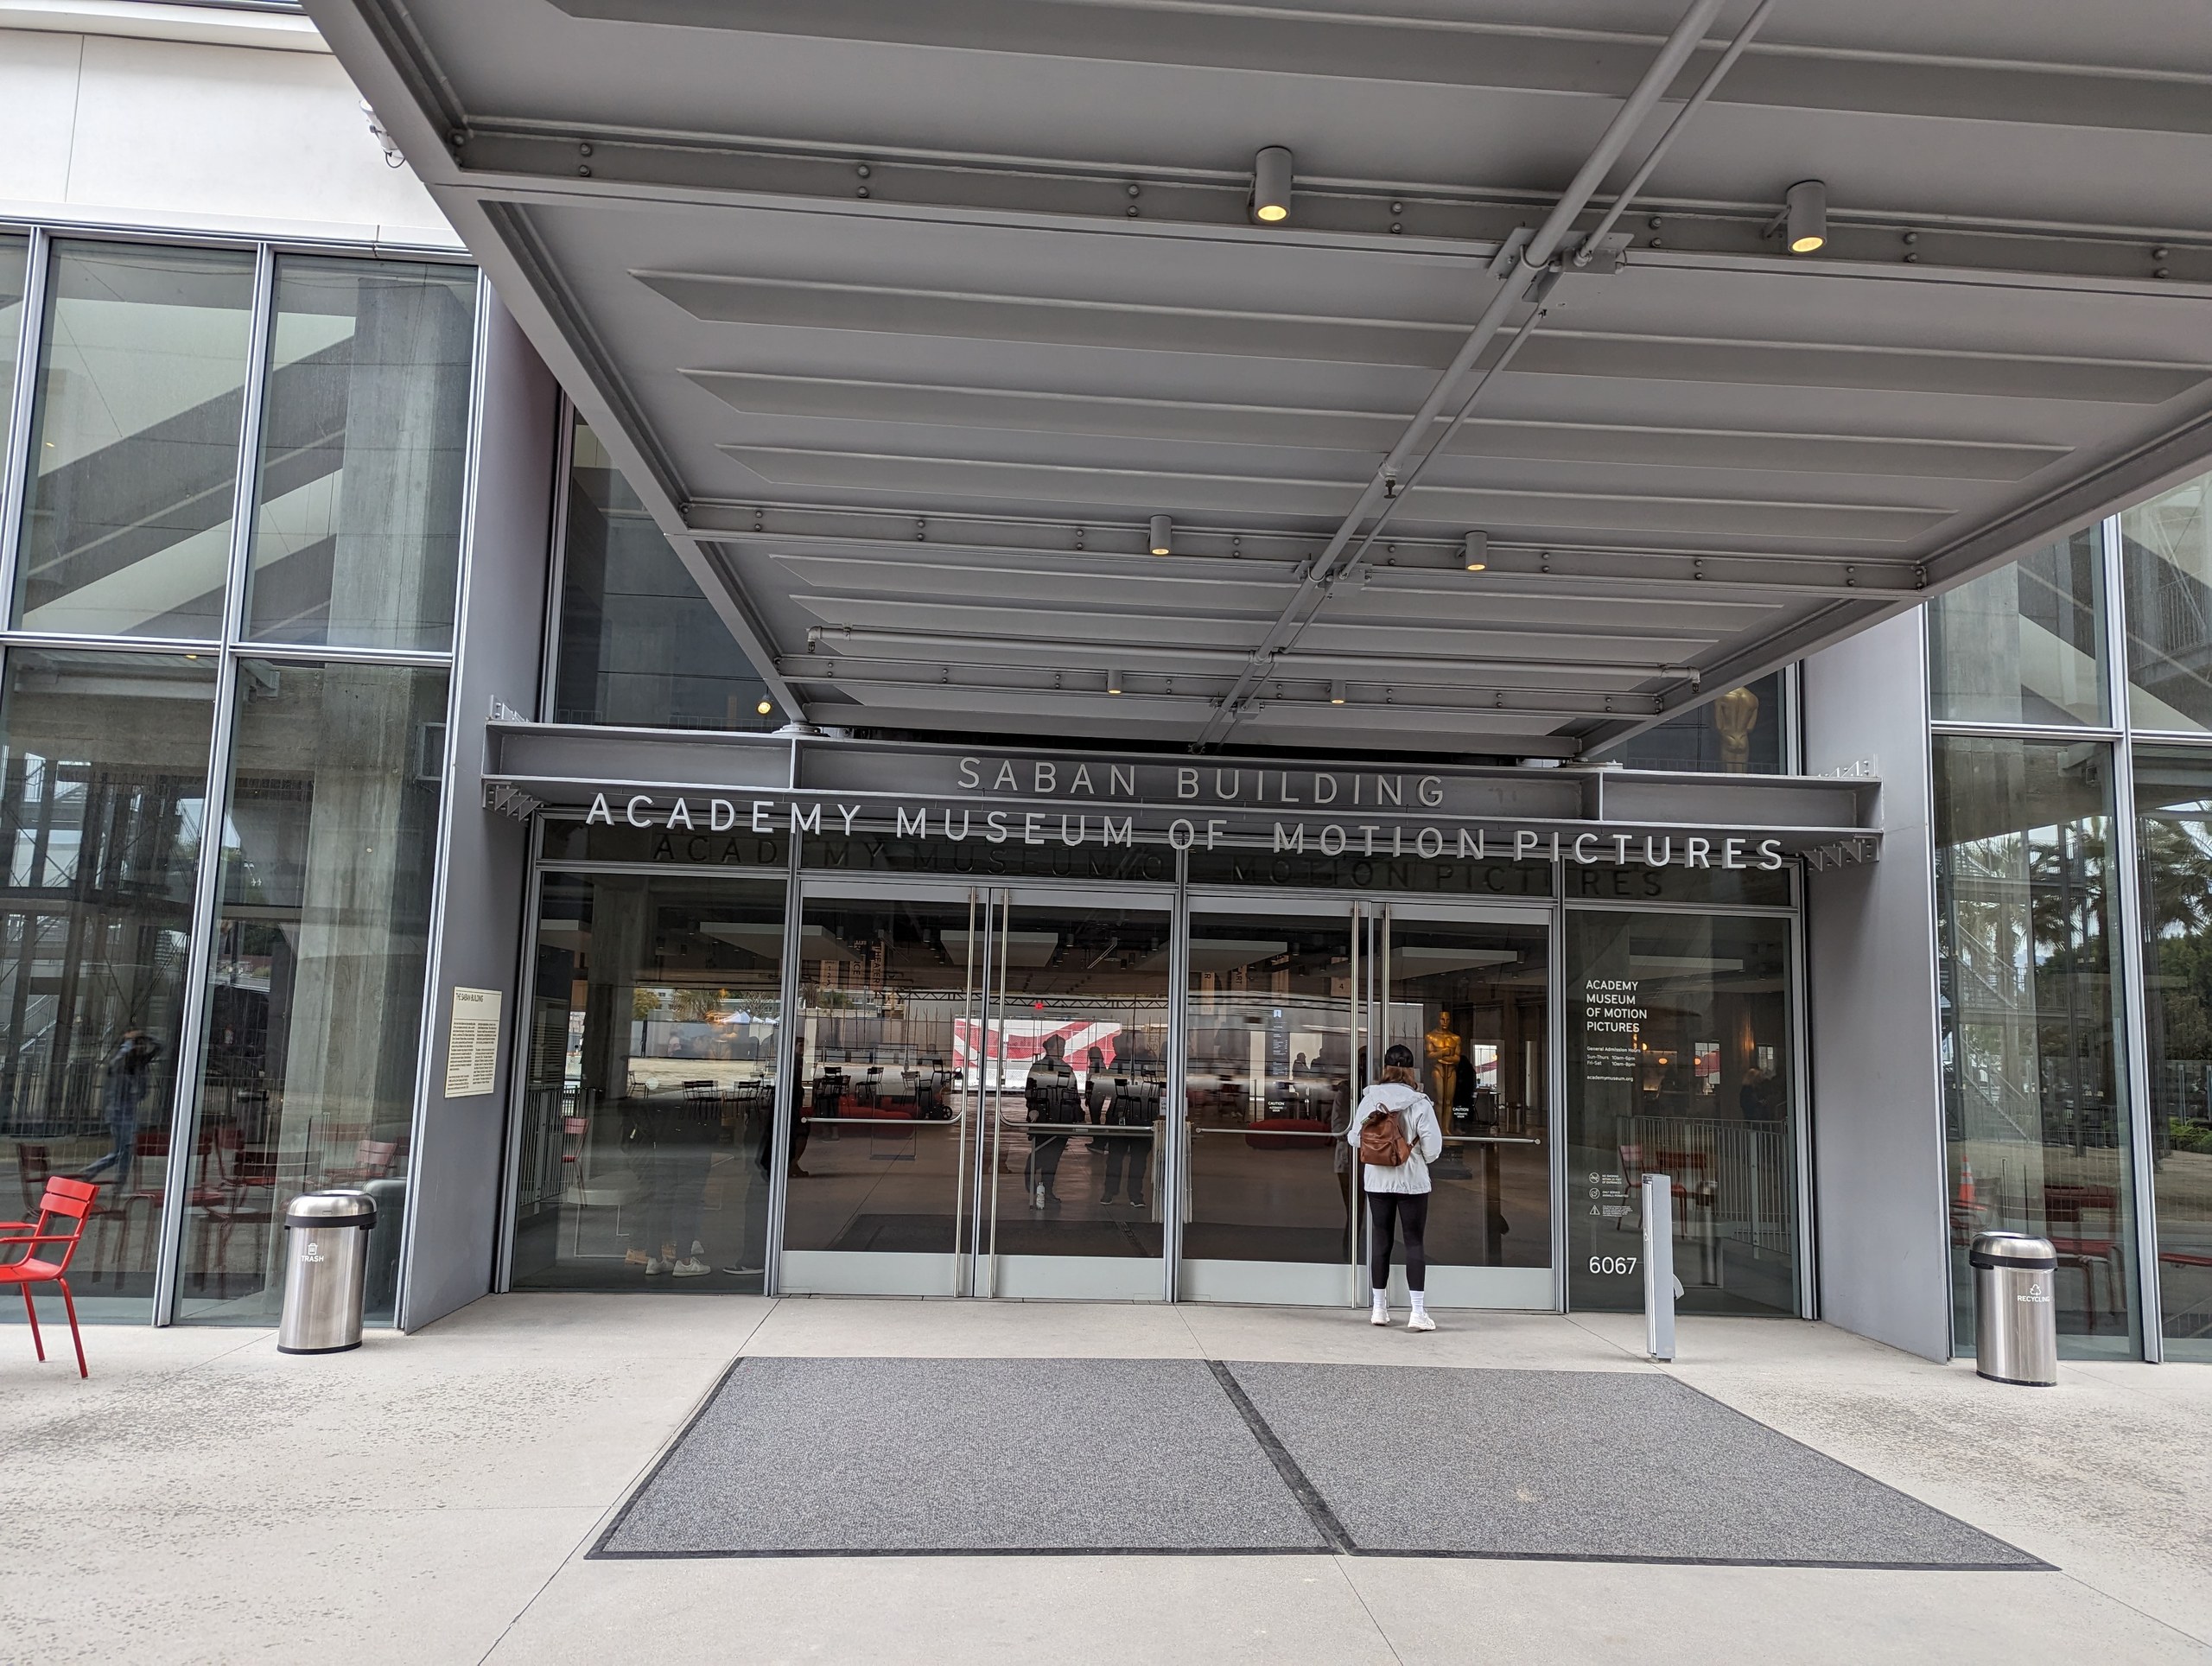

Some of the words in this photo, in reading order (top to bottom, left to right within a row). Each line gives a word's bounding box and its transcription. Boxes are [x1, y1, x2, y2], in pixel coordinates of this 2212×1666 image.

[957, 756, 1135, 797] SABAN
[1177, 766, 1445, 807] BUILDING
[585, 792, 862, 836] ACADEMY
[896, 806, 1133, 848] MUSEUM
[1168, 818, 1227, 851] OF
[1273, 822, 1484, 861] MOTION
[1513, 830, 1783, 871] PICTURES
[653, 835, 884, 867] ACADMY
[1586, 980, 1639, 991] ACADEMY
[1586, 993, 1636, 1005] MUSEUM
[1586, 1007, 1601, 1018] OF
[1604, 1008, 1648, 1019] MOTION
[1586, 1021, 1640, 1033] PICTURES
[1590, 1256, 1637, 1275] 6067
